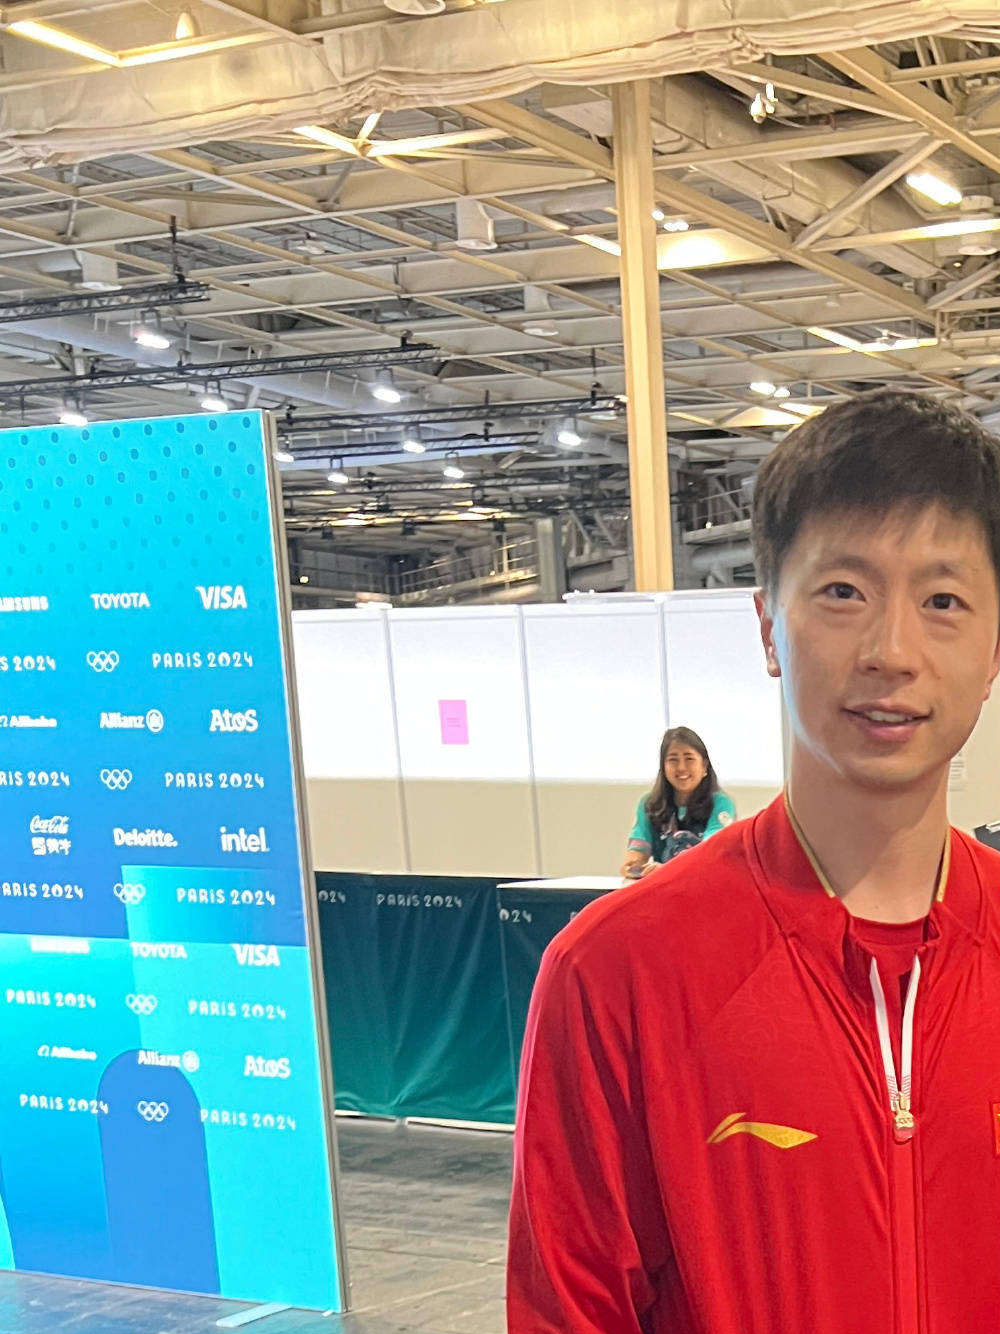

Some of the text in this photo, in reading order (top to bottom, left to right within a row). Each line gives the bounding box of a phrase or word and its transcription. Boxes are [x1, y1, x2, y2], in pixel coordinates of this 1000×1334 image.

[90, 592, 151, 609] TOYOTA
[195, 585, 248, 610] VISA
[13, 655, 56, 671] 2024
[152, 651, 253, 668] PARIS 2024
[100, 711, 145, 729] Allianz
[27, 771, 70, 786] 2024
[164, 772, 265, 788] PARIS 2024
[1, 882, 84, 900] ARIS 2024
[176, 888, 276, 906] PARIS 2024
[376, 893, 463, 907] PARIS 2024
[130, 941, 188, 959] TOYOTA
[231, 943, 281, 967] VISA
[6, 988, 97, 1008] PARIS 2024
[187, 1000, 287, 1020] PARIS 2024
[19, 1093, 109, 1115] PARIS 2024
[199, 1108, 296, 1131] PARIS 2024
